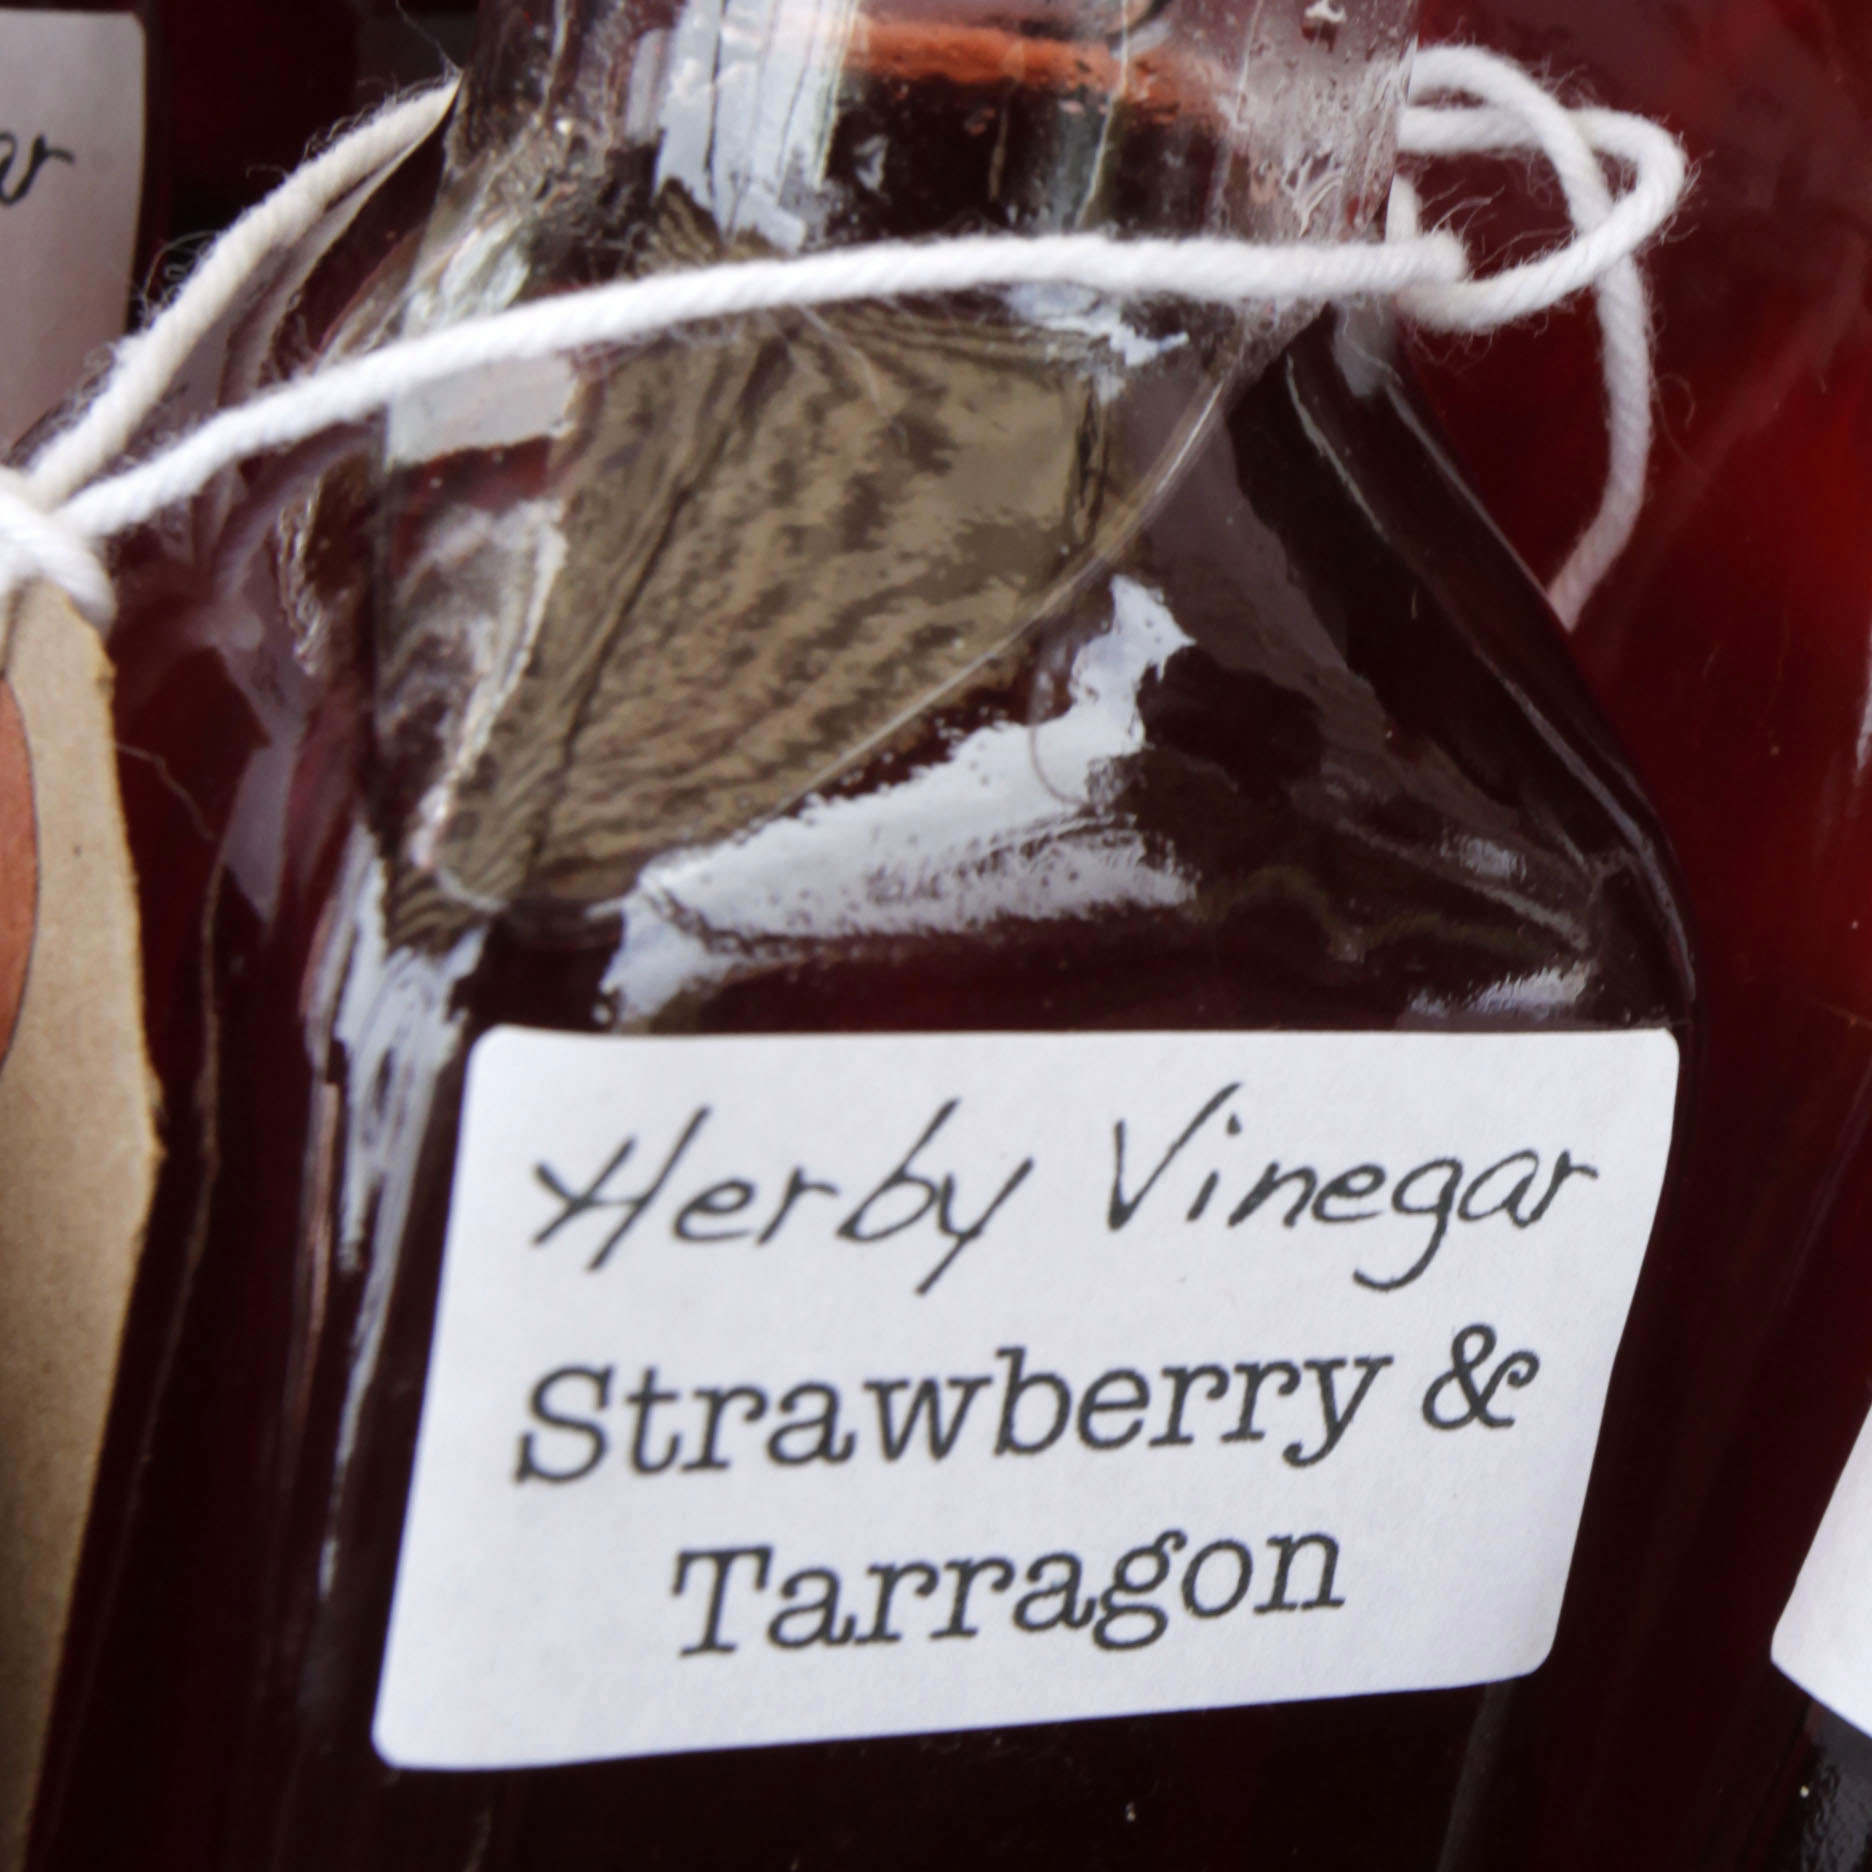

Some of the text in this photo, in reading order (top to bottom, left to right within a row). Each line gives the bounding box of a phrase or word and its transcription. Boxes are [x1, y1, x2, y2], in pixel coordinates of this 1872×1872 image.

[531, 1080, 1600, 1298] Herby Vinegar
[511, 1321, 1542, 1488] Strawberry &
[670, 1527, 1347, 1660] Tarragon
